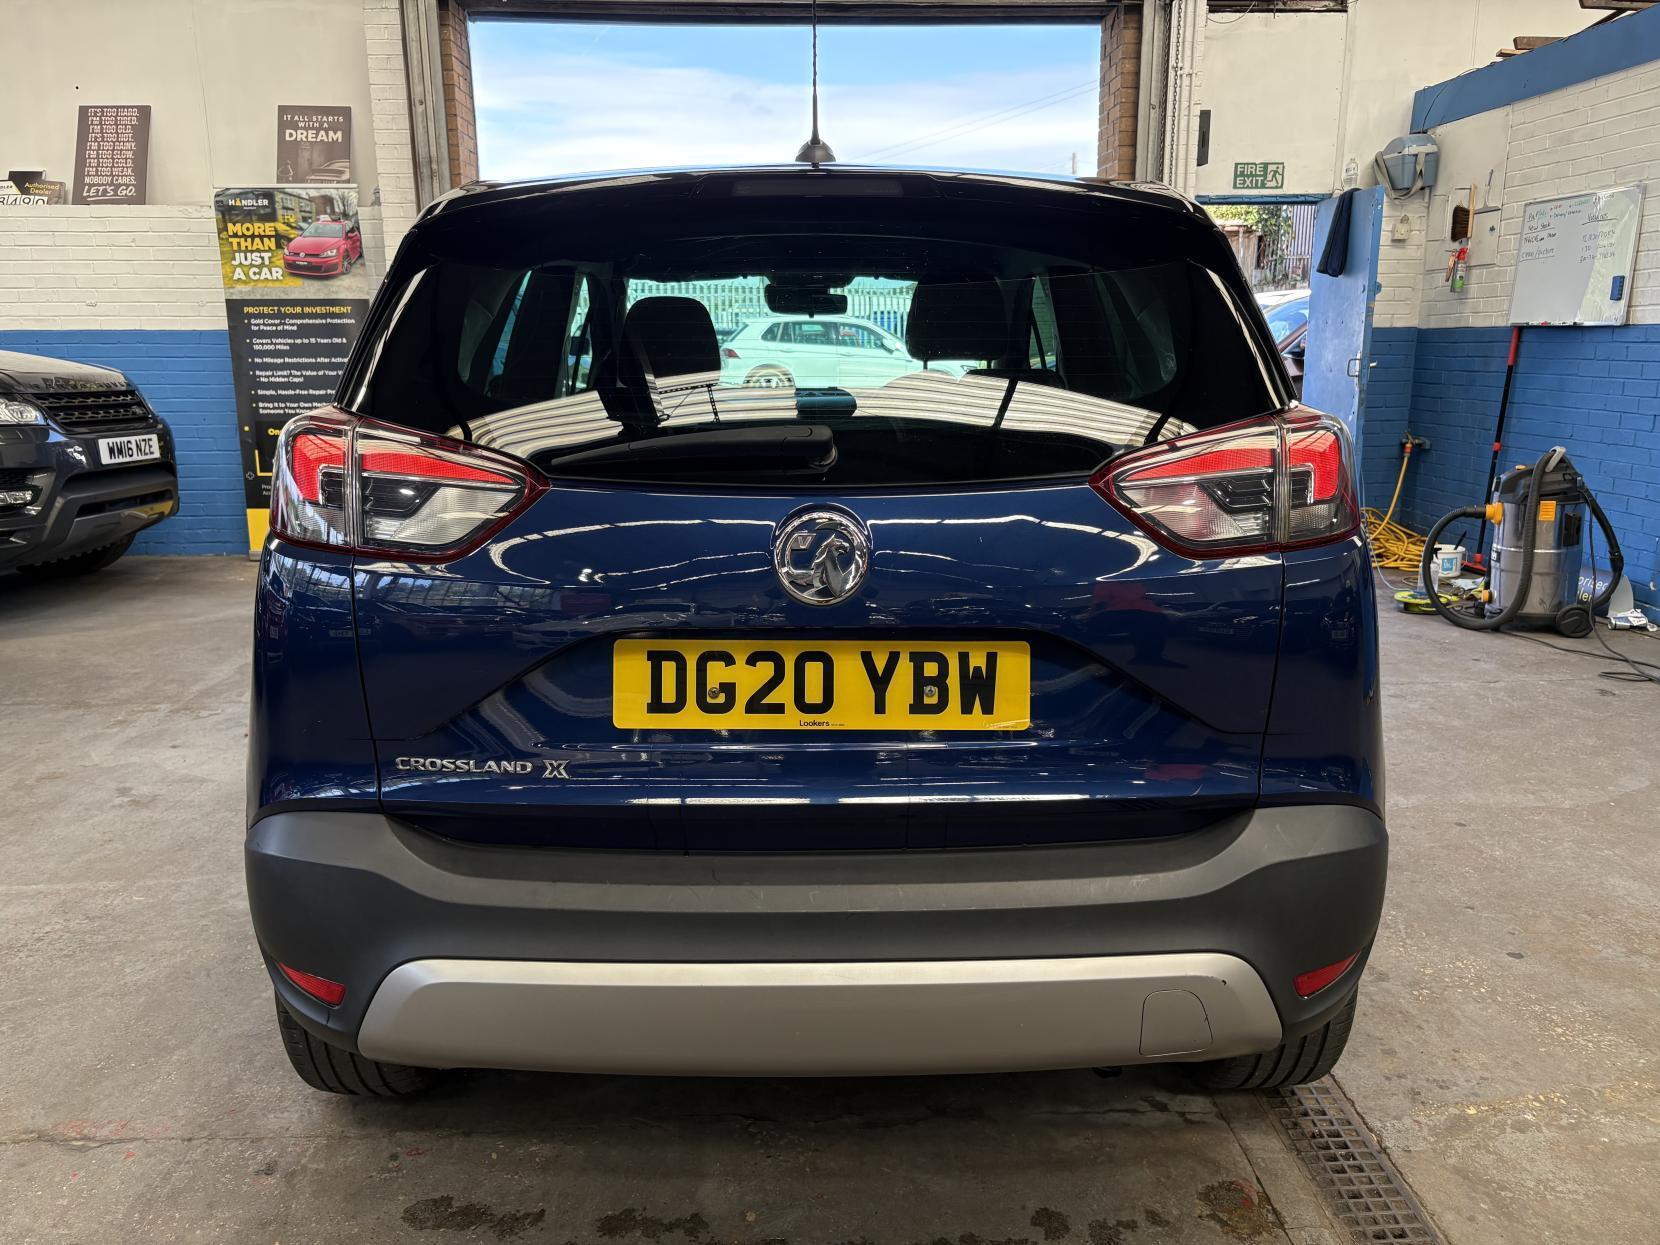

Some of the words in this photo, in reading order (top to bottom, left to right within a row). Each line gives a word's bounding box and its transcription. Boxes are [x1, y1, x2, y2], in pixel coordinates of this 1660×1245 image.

[285, 130, 342, 142] DREAM
[1237, 164, 1264, 174] FIRE
[1236, 177, 1264, 187] EXIT
[83, 186, 114, 196] LET'S
[118, 186, 136, 196] GO.
[227, 223, 276, 236] MORE
[229, 238, 276, 250] THAN
[232, 253, 272, 265] JUST
[233, 268, 247, 280] A
[249, 267, 283, 280] CAR
[107, 440, 134, 460] WM16
[135, 438, 155, 458] NZE
[646, 650, 835, 715] DG20
[860, 650, 998, 715] YBW
[395, 757, 533, 774] CROSSLAND
[542, 760, 570, 779] X
